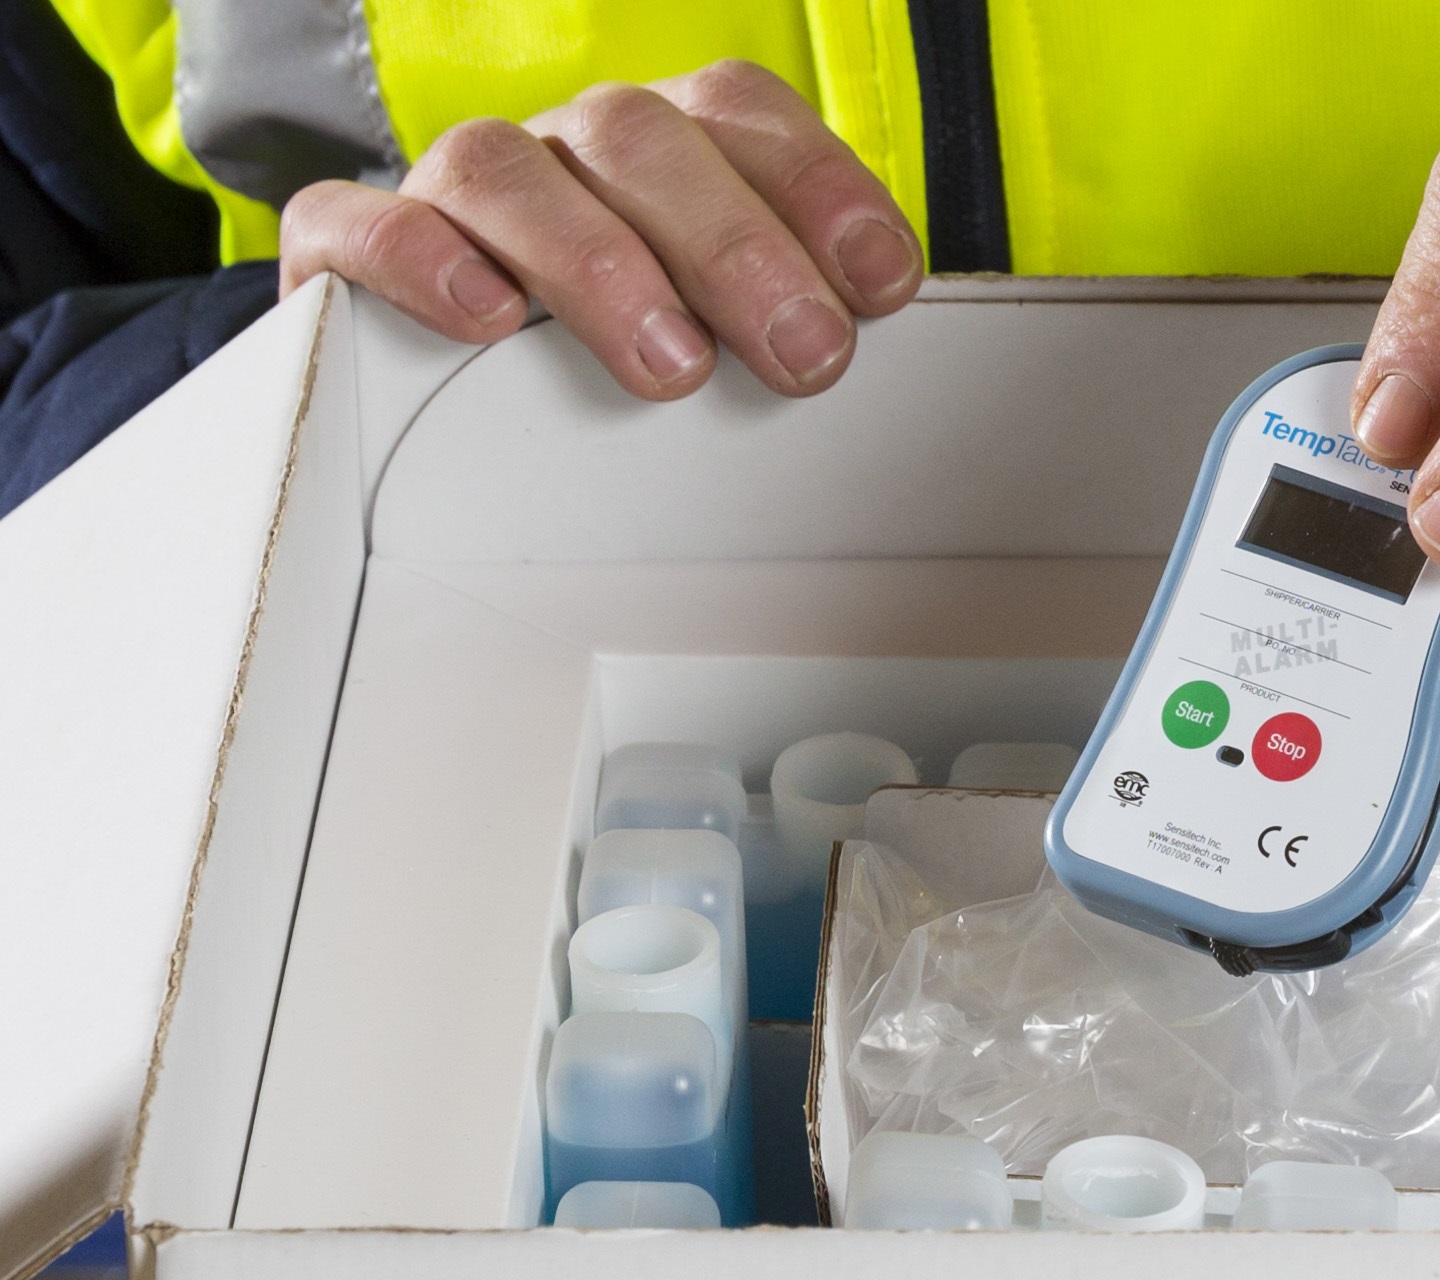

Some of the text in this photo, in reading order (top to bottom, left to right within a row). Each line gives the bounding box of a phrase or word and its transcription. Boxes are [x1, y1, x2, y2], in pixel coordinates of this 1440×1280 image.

[1264, 588, 1341, 621] SHIPPER/CARRIER
[1230, 616, 1338, 654] MULTI-
[1234, 638, 1338, 678] ALARM
[1240, 682, 1282, 703] PRODUCT
[1175, 700, 1215, 728] Start
[1267, 733, 1307, 761] Stop
[1148, 829, 1231, 866] www.sensitech.com
[1164, 821, 1206, 844] Sensitech
